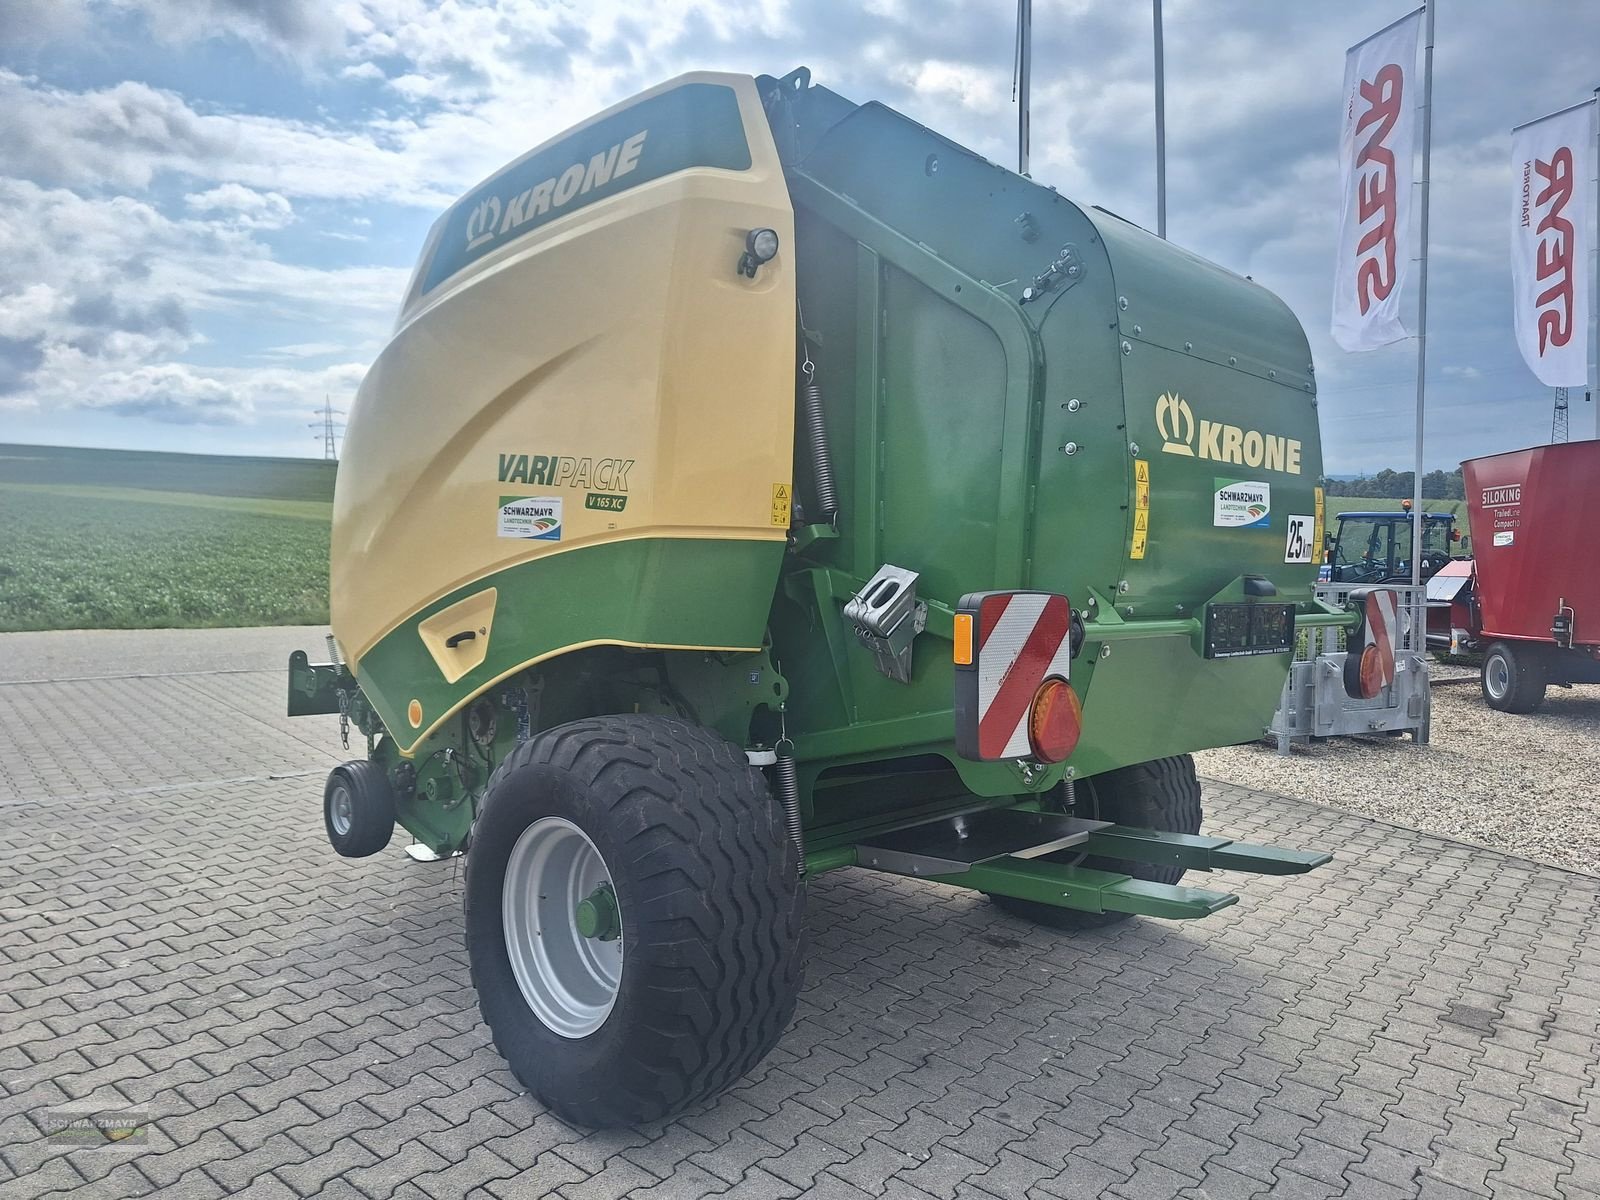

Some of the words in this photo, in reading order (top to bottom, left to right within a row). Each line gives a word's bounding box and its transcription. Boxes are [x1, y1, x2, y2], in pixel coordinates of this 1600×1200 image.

[499, 129, 648, 234] KRONE
[1199, 420, 1301, 475] KRONE
[498, 453, 635, 491] VARIPACK
[589, 496, 596, 506] V
[596, 497, 610, 508] 165
[610, 498, 623, 509] XC
[1219, 490, 1264, 503] SCHWARZMAYR
[1482, 488, 1521, 505] SILOKING
[503, 506, 553, 517] SCHWARZMAYR
[1220, 503, 1247, 511] LANDTECHNIK
[1287, 520, 1303, 559] 25
[1302, 538, 1312, 559] km
